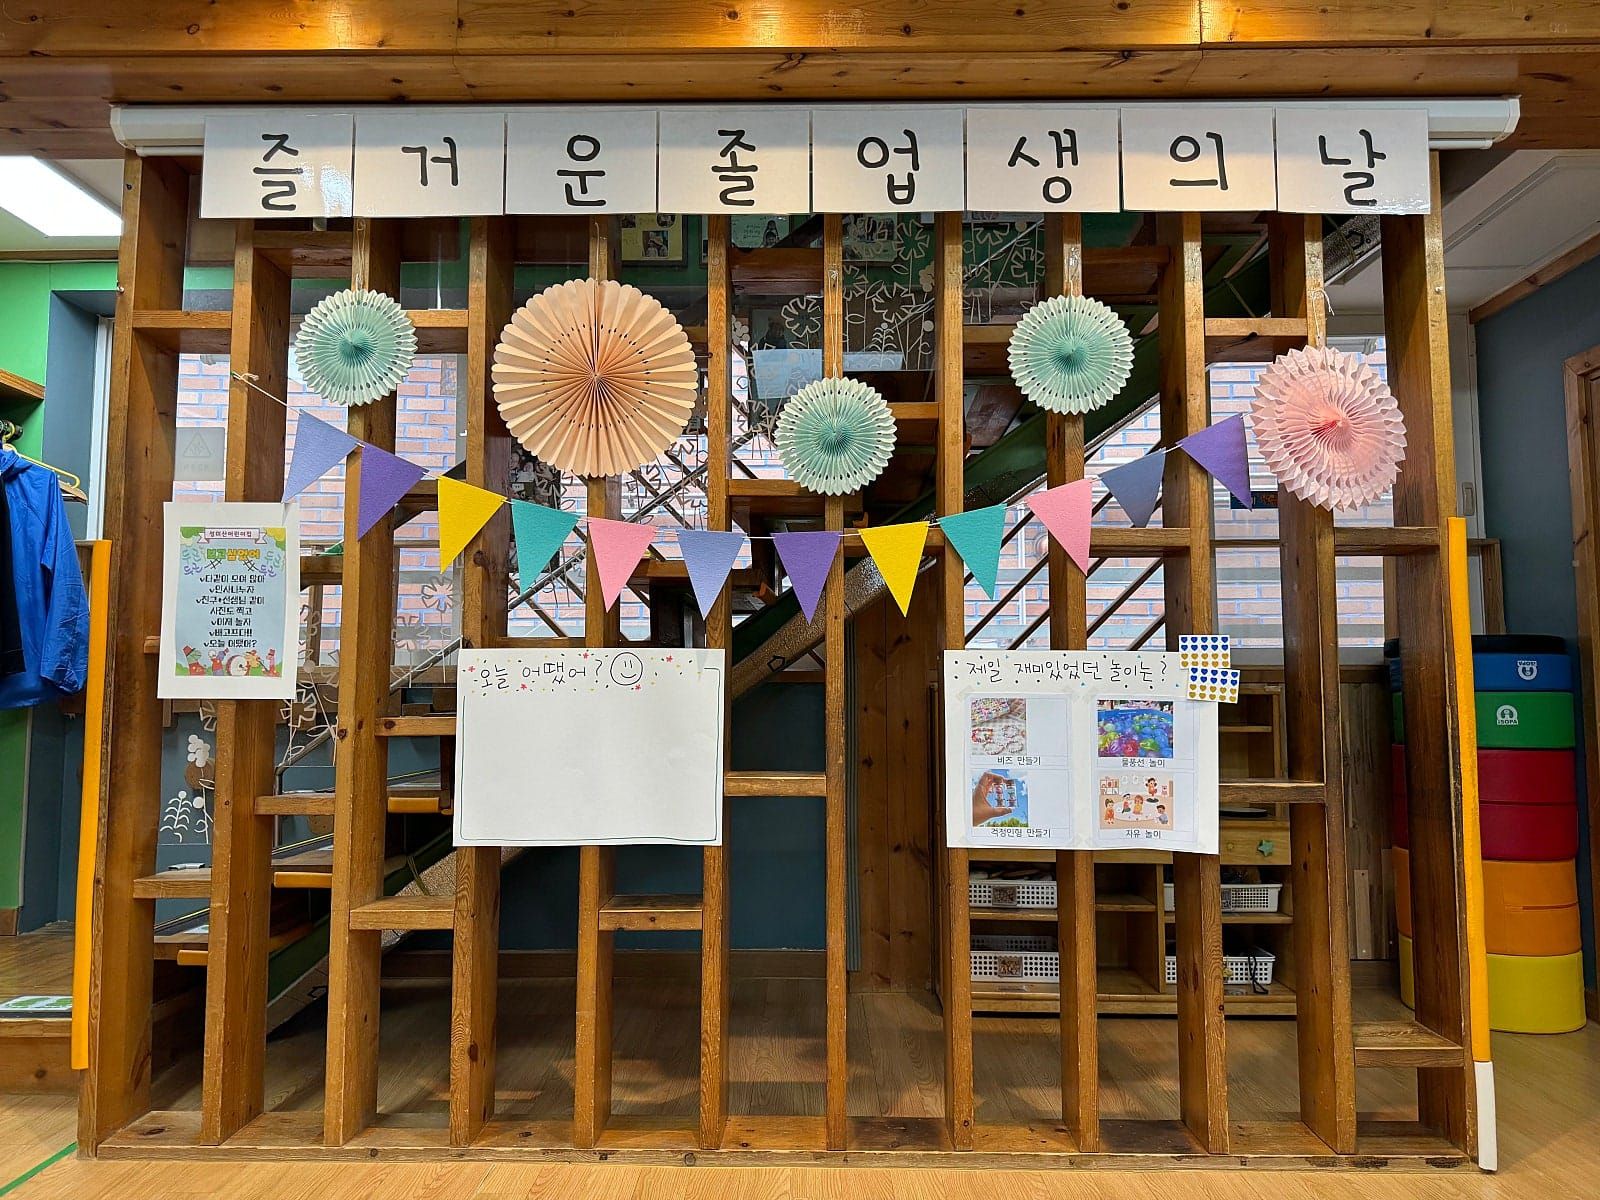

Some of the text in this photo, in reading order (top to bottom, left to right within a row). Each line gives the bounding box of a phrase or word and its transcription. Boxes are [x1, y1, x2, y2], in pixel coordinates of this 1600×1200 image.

[1318, 128, 1387, 207] 날
[230, 574, 247, 583] 모여
[215, 584, 255, 594] 인사나누자
[210, 606, 234, 616] 사진도
[209, 639, 225, 648] 오늘
[966, 658, 1003, 683] 제일
[1013, 660, 1103, 681] 재미있었던
[480, 664, 510, 690] 오늘
[997, 756, 1041, 766] 비즈 만들기
[1148, 758, 1166, 768] 놀이
[1026, 828, 1051, 839] 만들기
[1125, 829, 1161, 839] 자유 놀이
